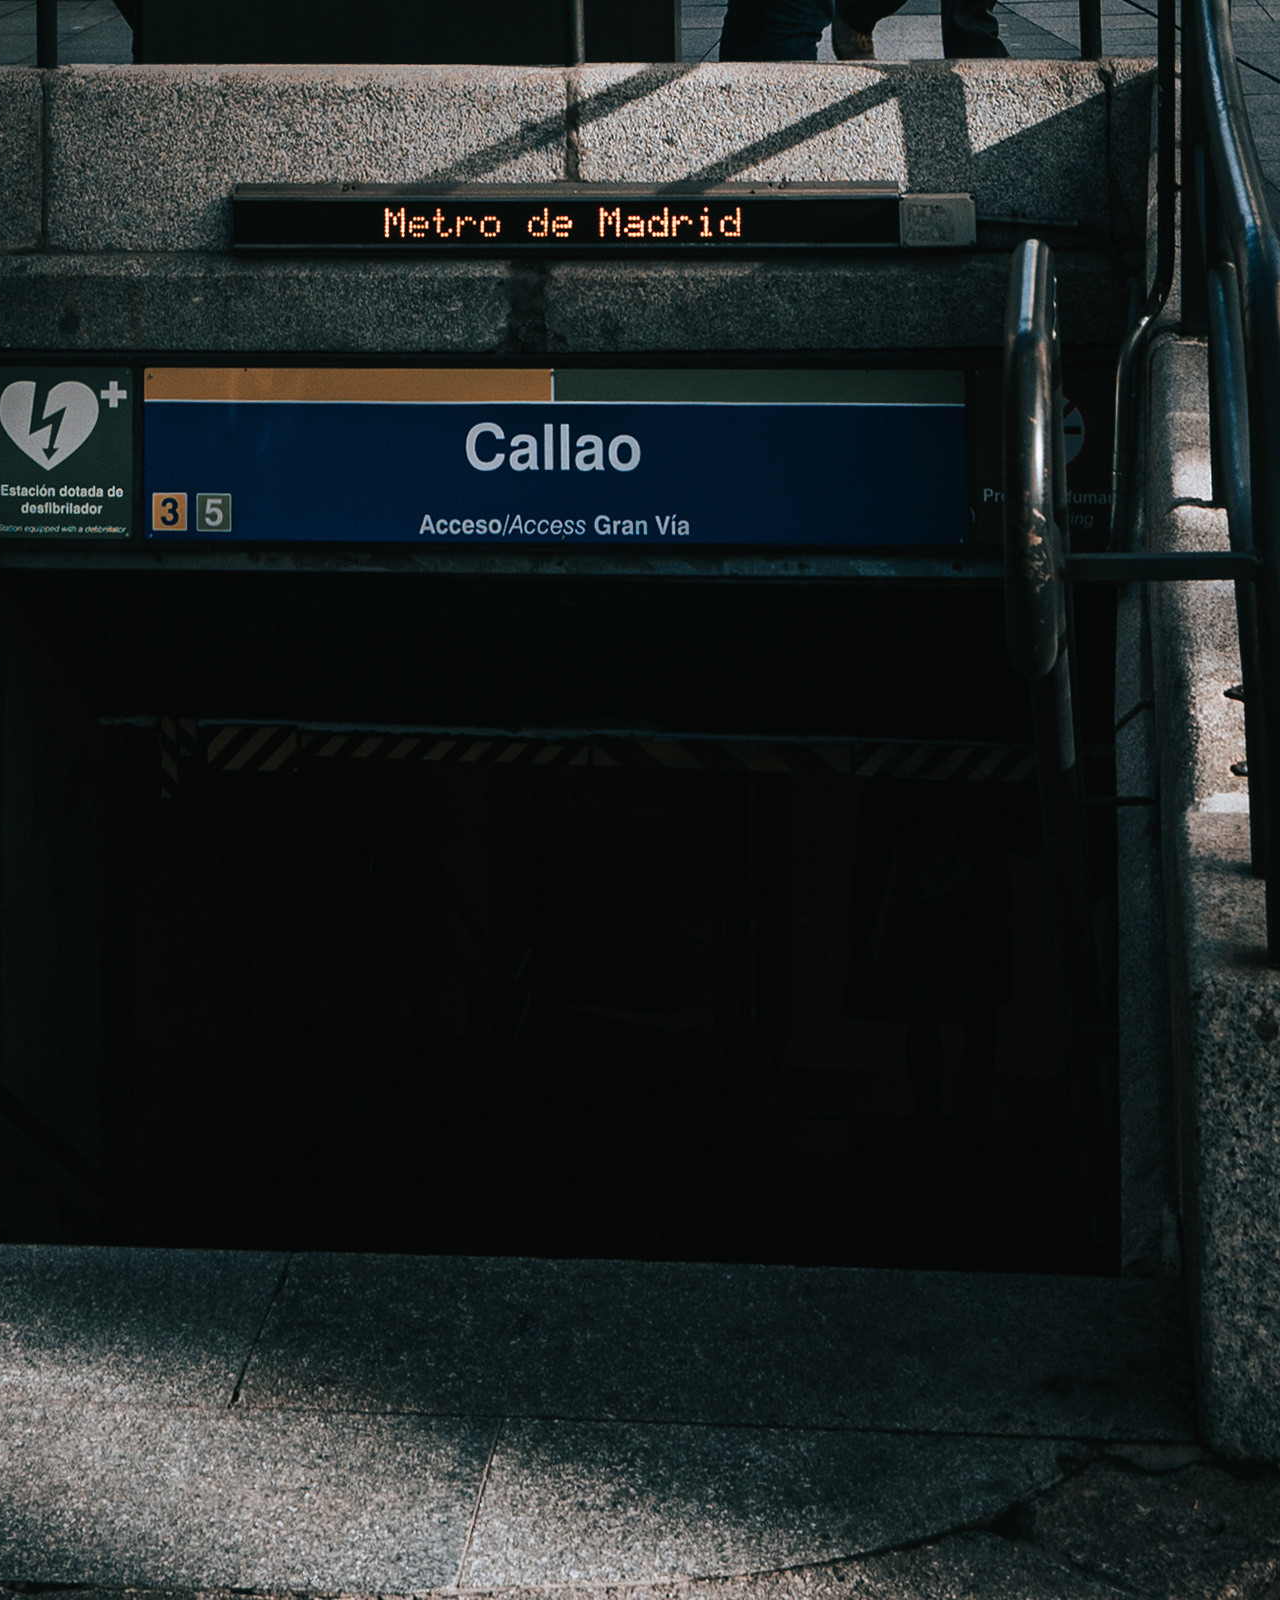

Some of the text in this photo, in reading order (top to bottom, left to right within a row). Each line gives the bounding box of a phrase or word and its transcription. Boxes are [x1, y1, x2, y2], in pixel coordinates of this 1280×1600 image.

[384, 207, 741, 238] Metro de Madrid
[465, 422, 641, 472] Callao
[0, 484, 124, 498] Estación dotada de
[21, 502, 103, 515] desfibrilador
[160, 497, 179, 526] 3
[205, 498, 223, 527] 5
[24, 524, 60, 535] equipped
[61, 525, 77, 533] with
[593, 515, 648, 536] Gran
[655, 514, 690, 536] Vía
